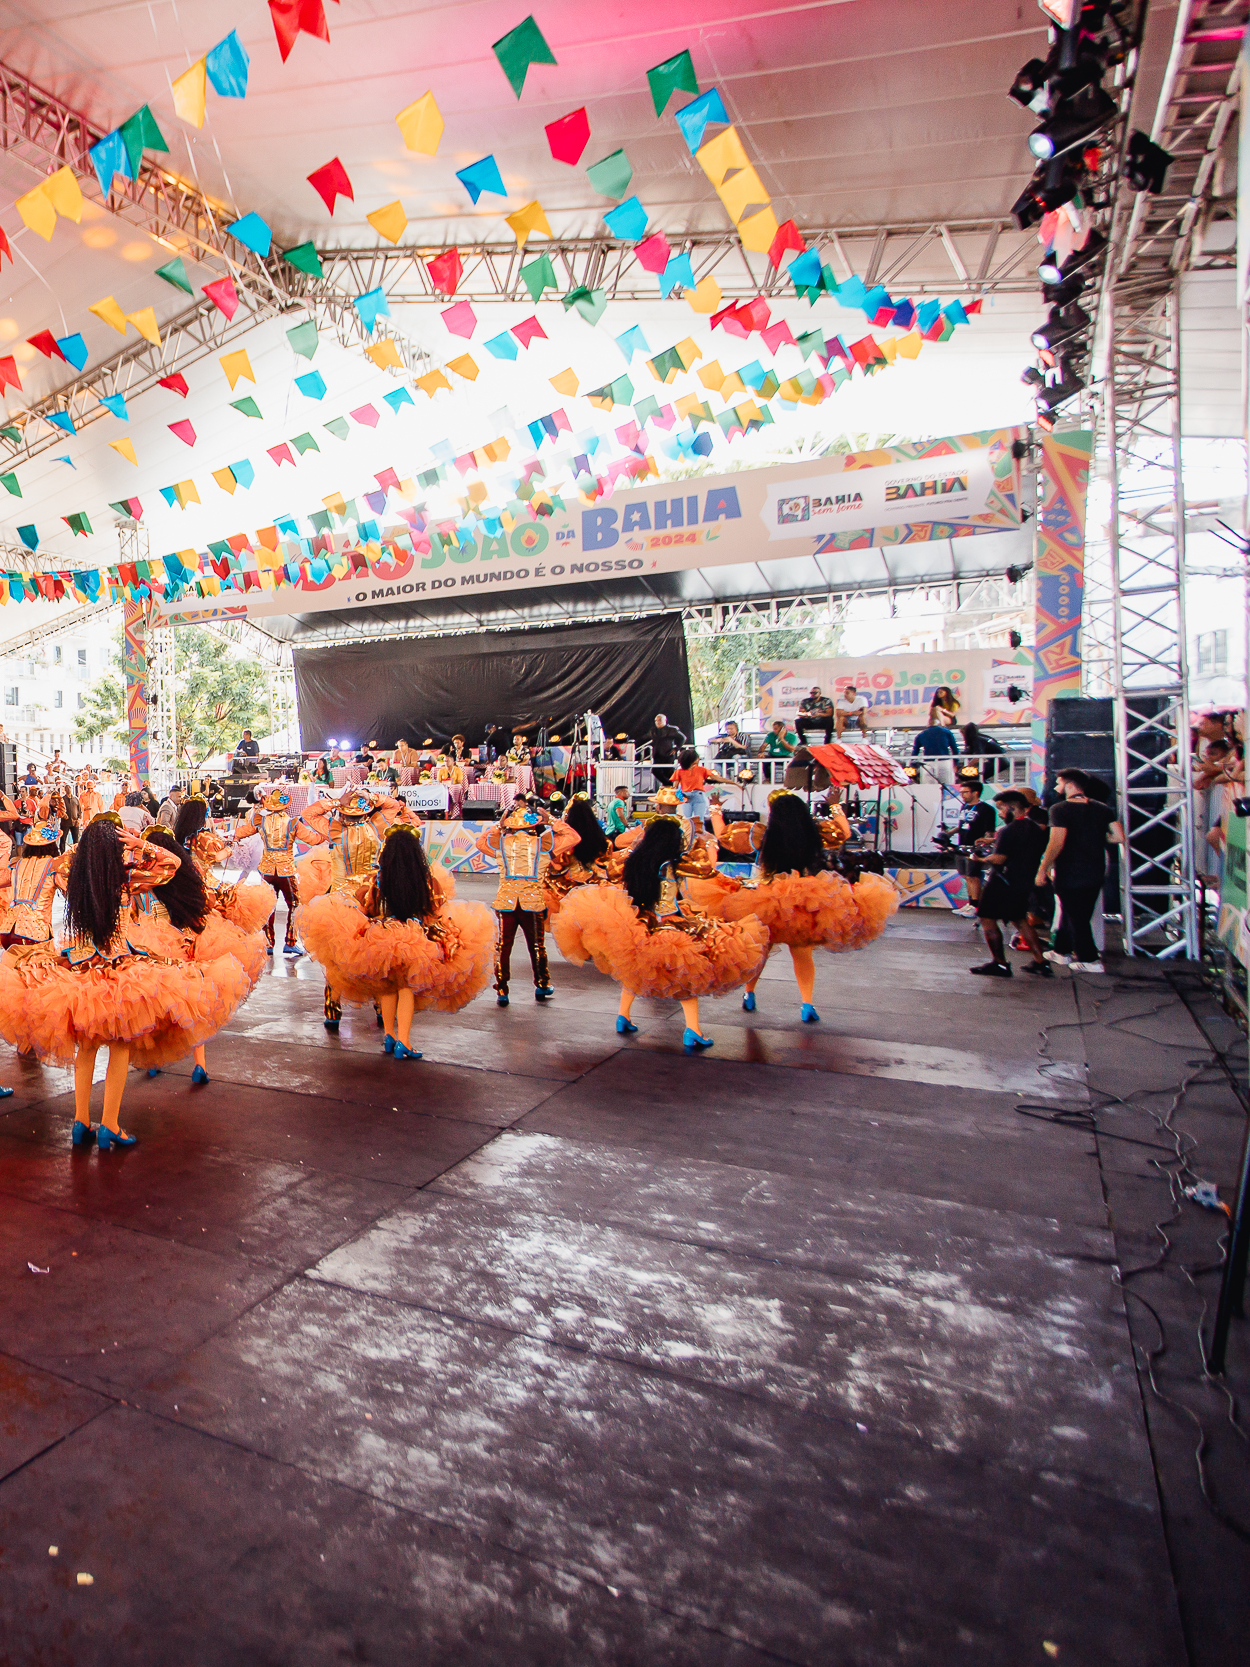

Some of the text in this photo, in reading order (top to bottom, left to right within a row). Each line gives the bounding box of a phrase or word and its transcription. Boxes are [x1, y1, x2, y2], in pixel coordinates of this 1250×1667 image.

[884, 475, 923, 486] GOVERNO
[938, 469, 968, 478] ESTADO
[885, 476, 968, 502] BAHIA
[812, 492, 864, 508] BAHIA
[555, 528, 576, 542] DA
[581, 485, 742, 552] BAHIA
[811, 506, 833, 517] sem
[650, 531, 697, 547] 2024
[355, 558, 644, 602] O MAIOR DO MUNDO É O NOSSO
[835, 668, 966, 693] SÃO JOÃO
[884, 708, 912, 716] 2024
